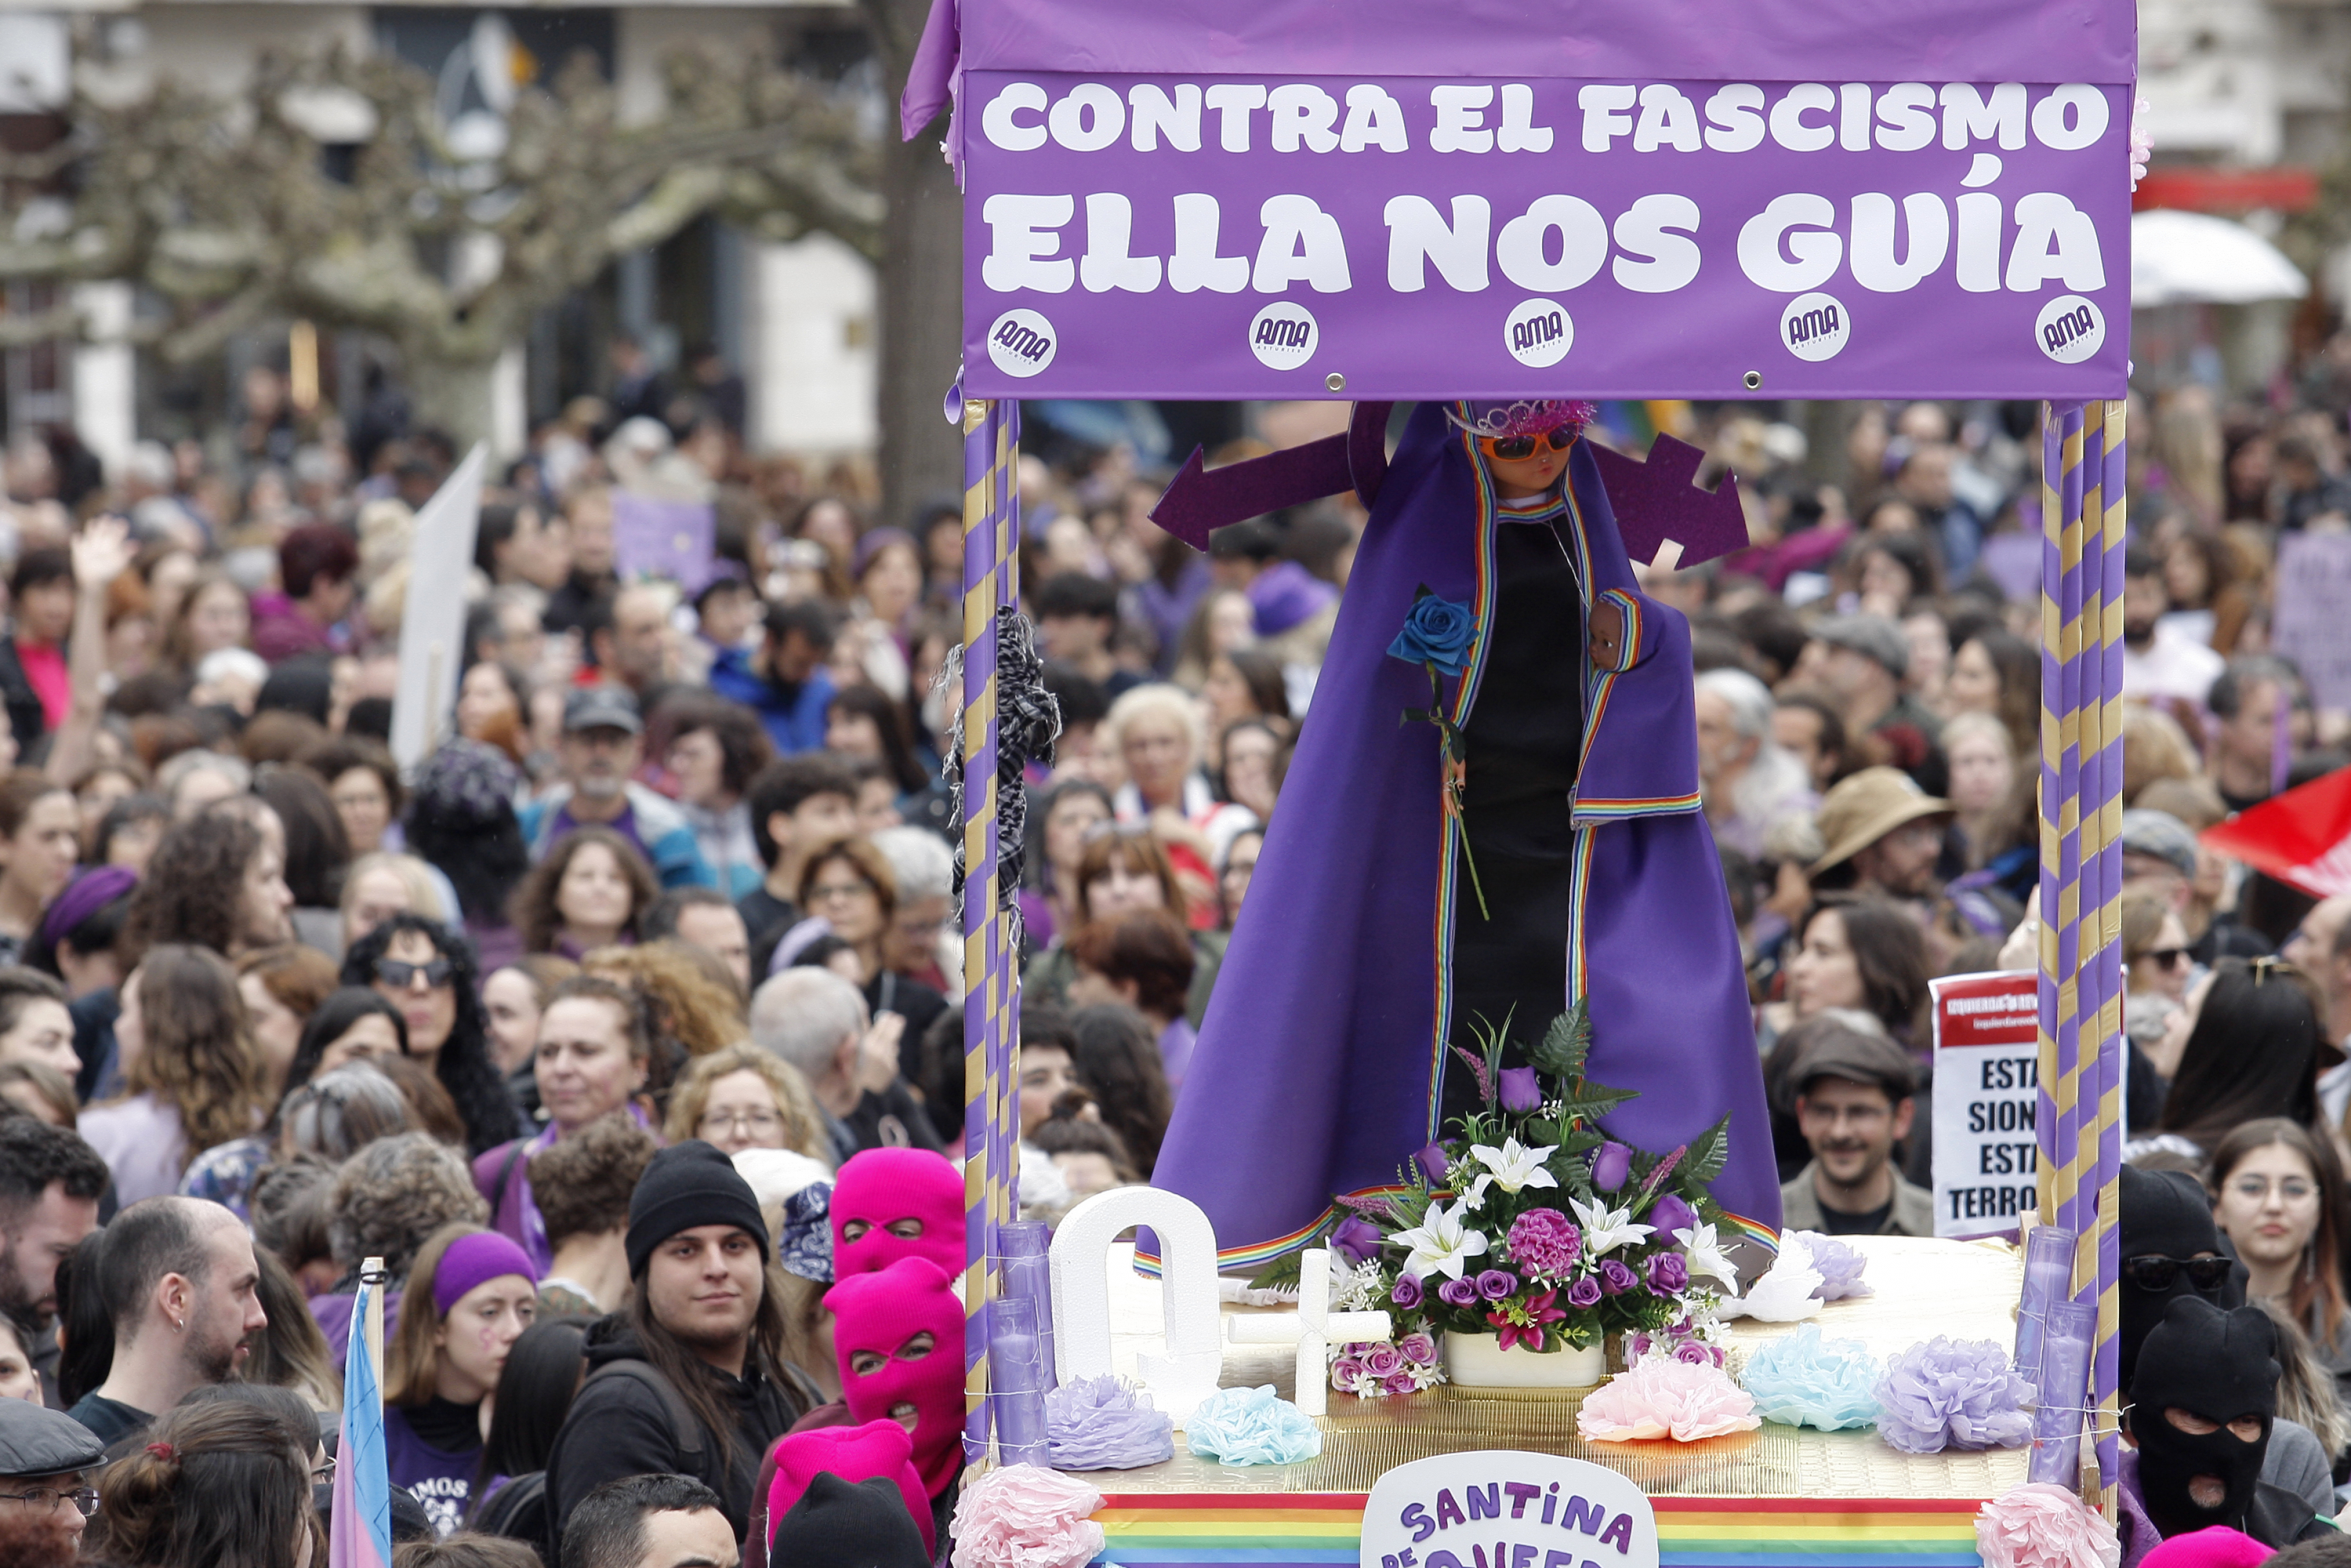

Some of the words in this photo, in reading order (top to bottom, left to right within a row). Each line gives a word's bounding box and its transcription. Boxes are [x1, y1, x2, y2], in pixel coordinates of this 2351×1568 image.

[981, 82, 1410, 154] CONTRA
[1429, 83, 1555, 154] EL
[1578, 82, 2110, 153] FASCISMO
[981, 192, 1352, 294] ELLA
[1384, 193, 1702, 292] NOS
[1736, 153, 2107, 292] GUÍA
[993, 320, 1050, 362] AMA
[1255, 318, 1310, 348] AMA
[1513, 311, 1563, 351] AMA
[1789, 305, 1839, 345] AMA
[2044, 305, 2095, 352] AMA
[1968, 1101, 2036, 1132] SION
[1949, 1186, 2037, 1219] TERRO
[1381, 1547, 1418, 1568] DE
